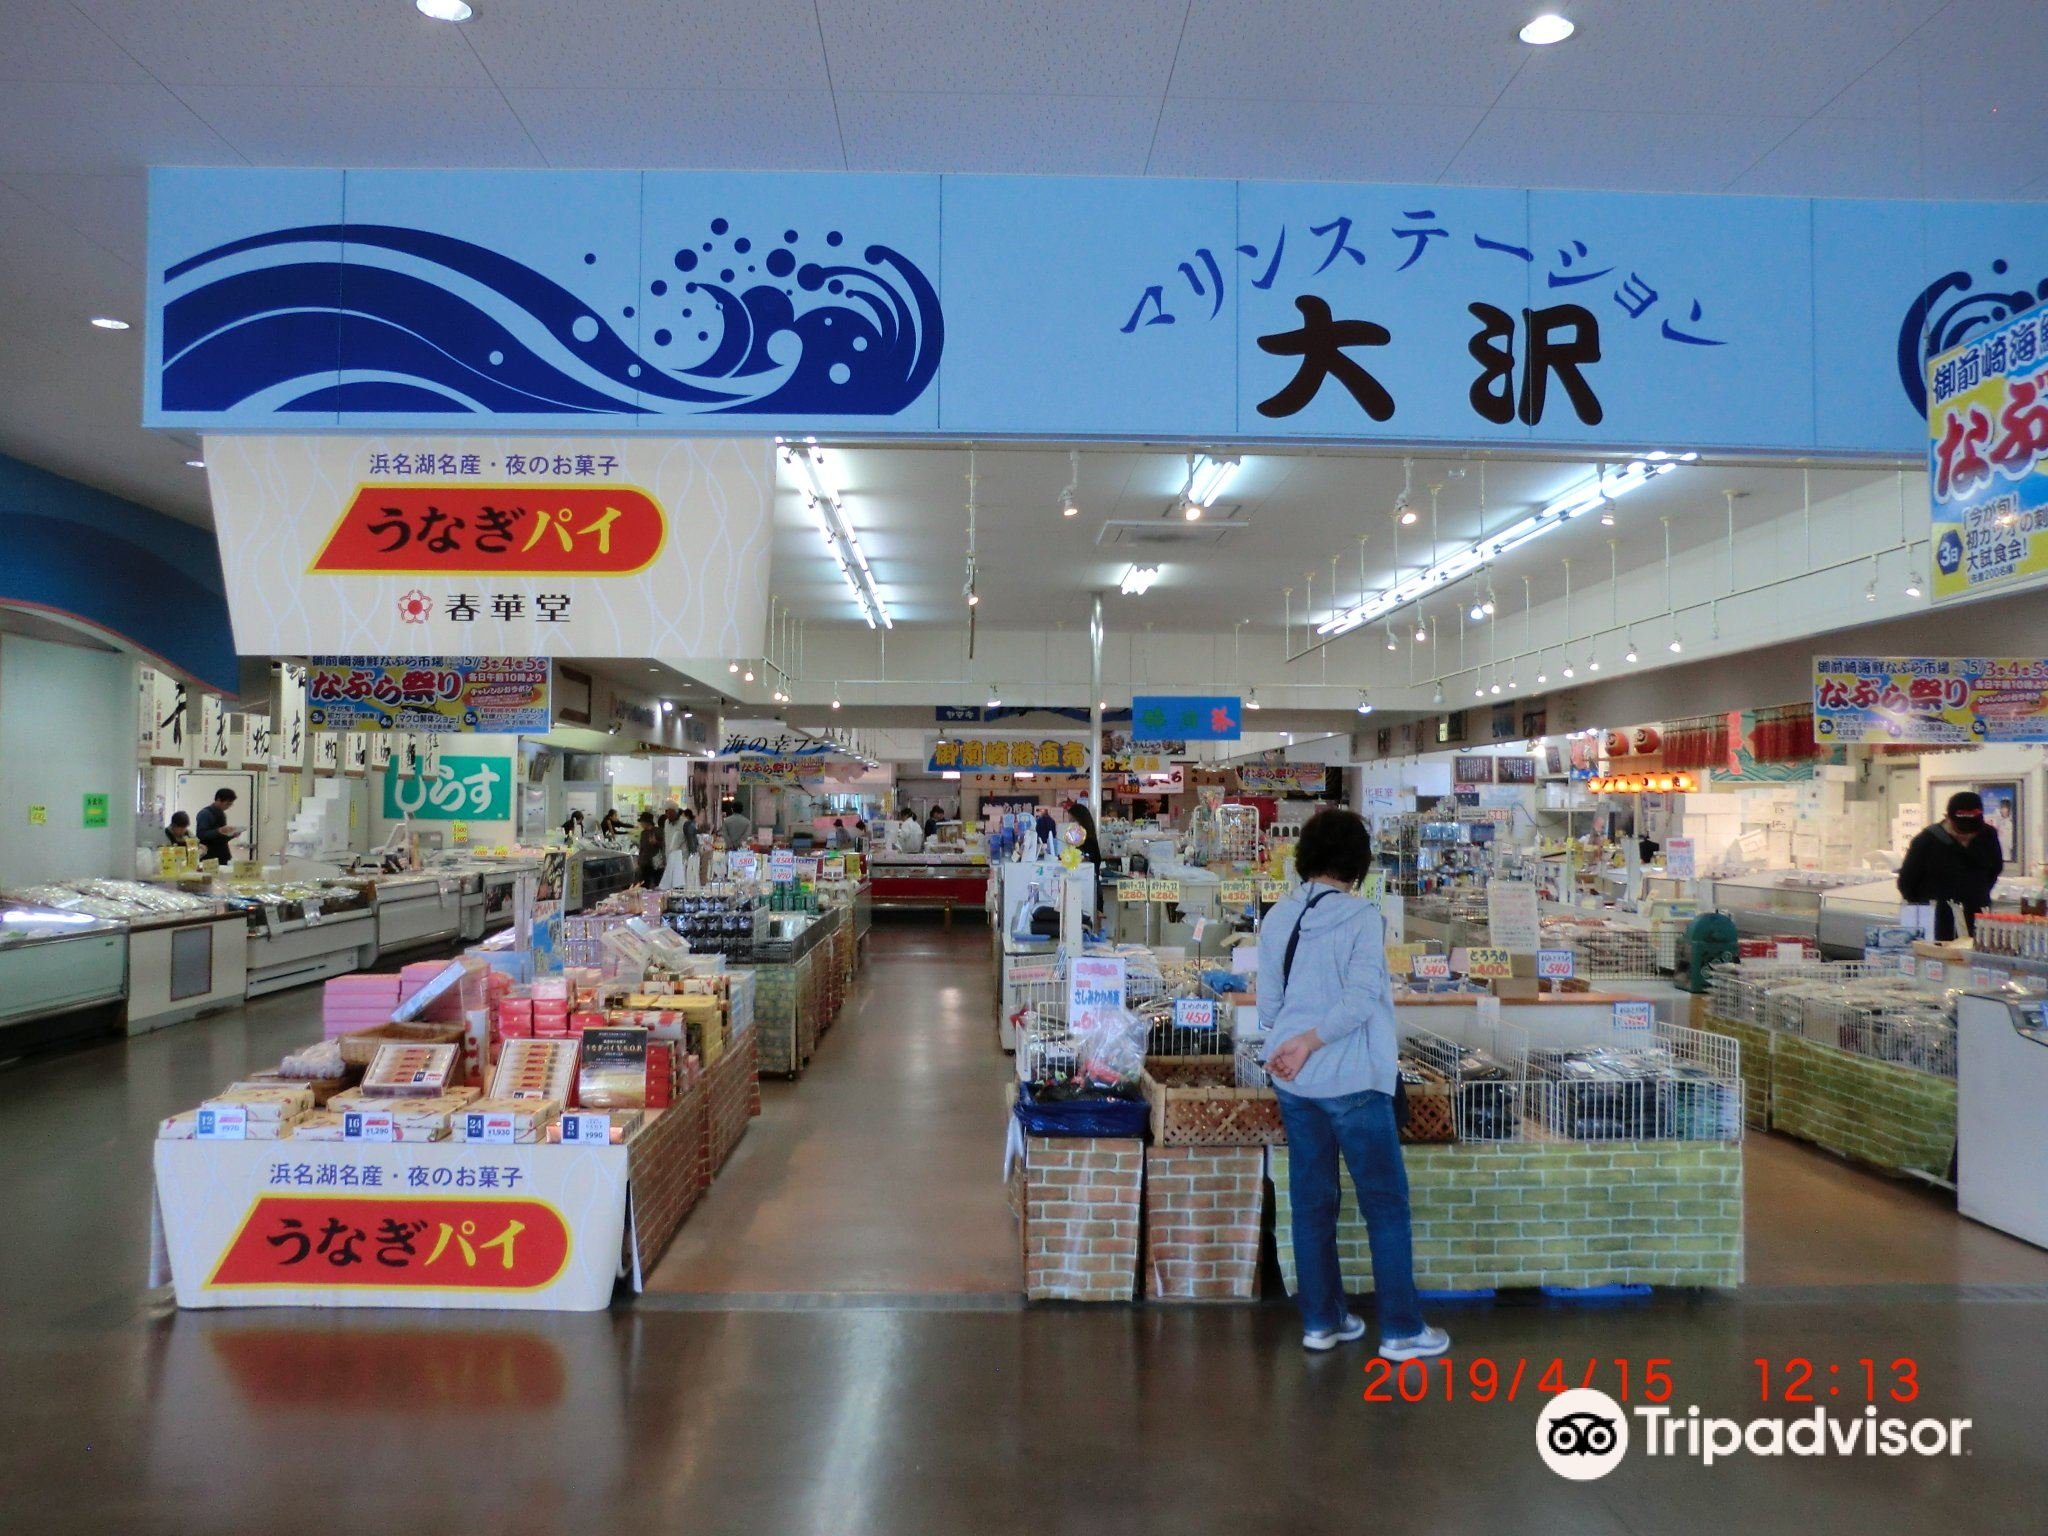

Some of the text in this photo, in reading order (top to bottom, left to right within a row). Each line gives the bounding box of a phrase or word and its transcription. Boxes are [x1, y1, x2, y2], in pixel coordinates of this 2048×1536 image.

[1121, 210, 1728, 346] マリンステーション
[1257, 295, 1603, 426] 大沢
[370, 454, 619, 476] 浜名湖名産・夜のお菓子
[367, 506, 622, 554] うなぎパイ
[445, 593, 571, 622] 春華堂
[311, 671, 463, 704] なぶら祭り
[1820, 678, 1969, 713] なぶら祭り
[395, 763, 500, 815] しらす
[1185, 1011, 1210, 1023] 450
[202, 1115, 213, 1126] 12
[348, 1118, 360, 1128] 16
[469, 1119, 482, 1129] 24
[567, 1121, 575, 1130] 5
[269, 1163, 523, 1188] 浜名湖名産・夜のお菓子
[267, 1217, 526, 1269] うなぎパイ
